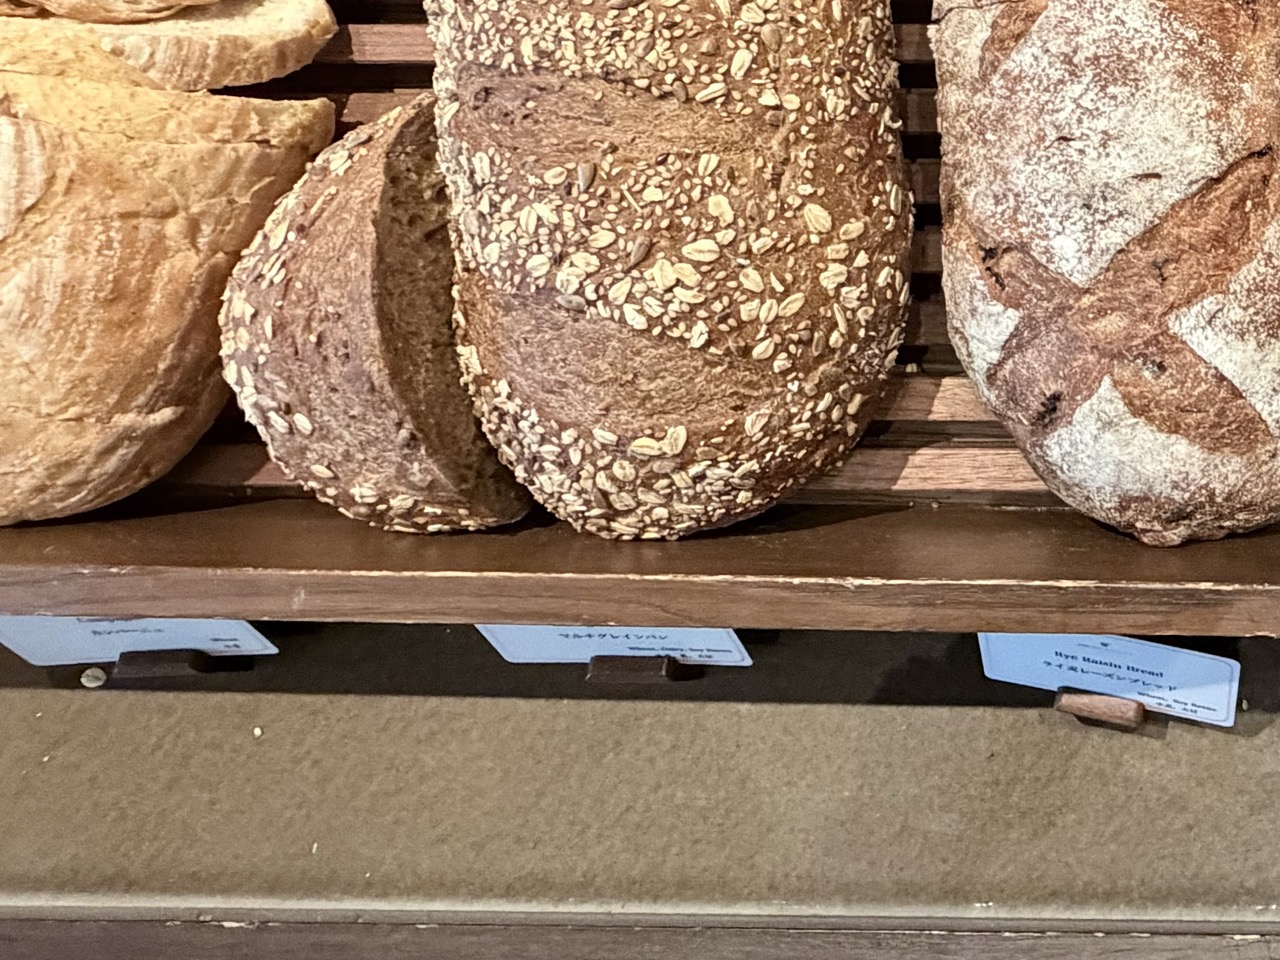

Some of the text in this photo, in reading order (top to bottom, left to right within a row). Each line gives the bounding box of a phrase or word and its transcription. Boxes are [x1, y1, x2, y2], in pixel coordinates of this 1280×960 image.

[1054, 651, 1164, 678] Rye Raisin Bread
